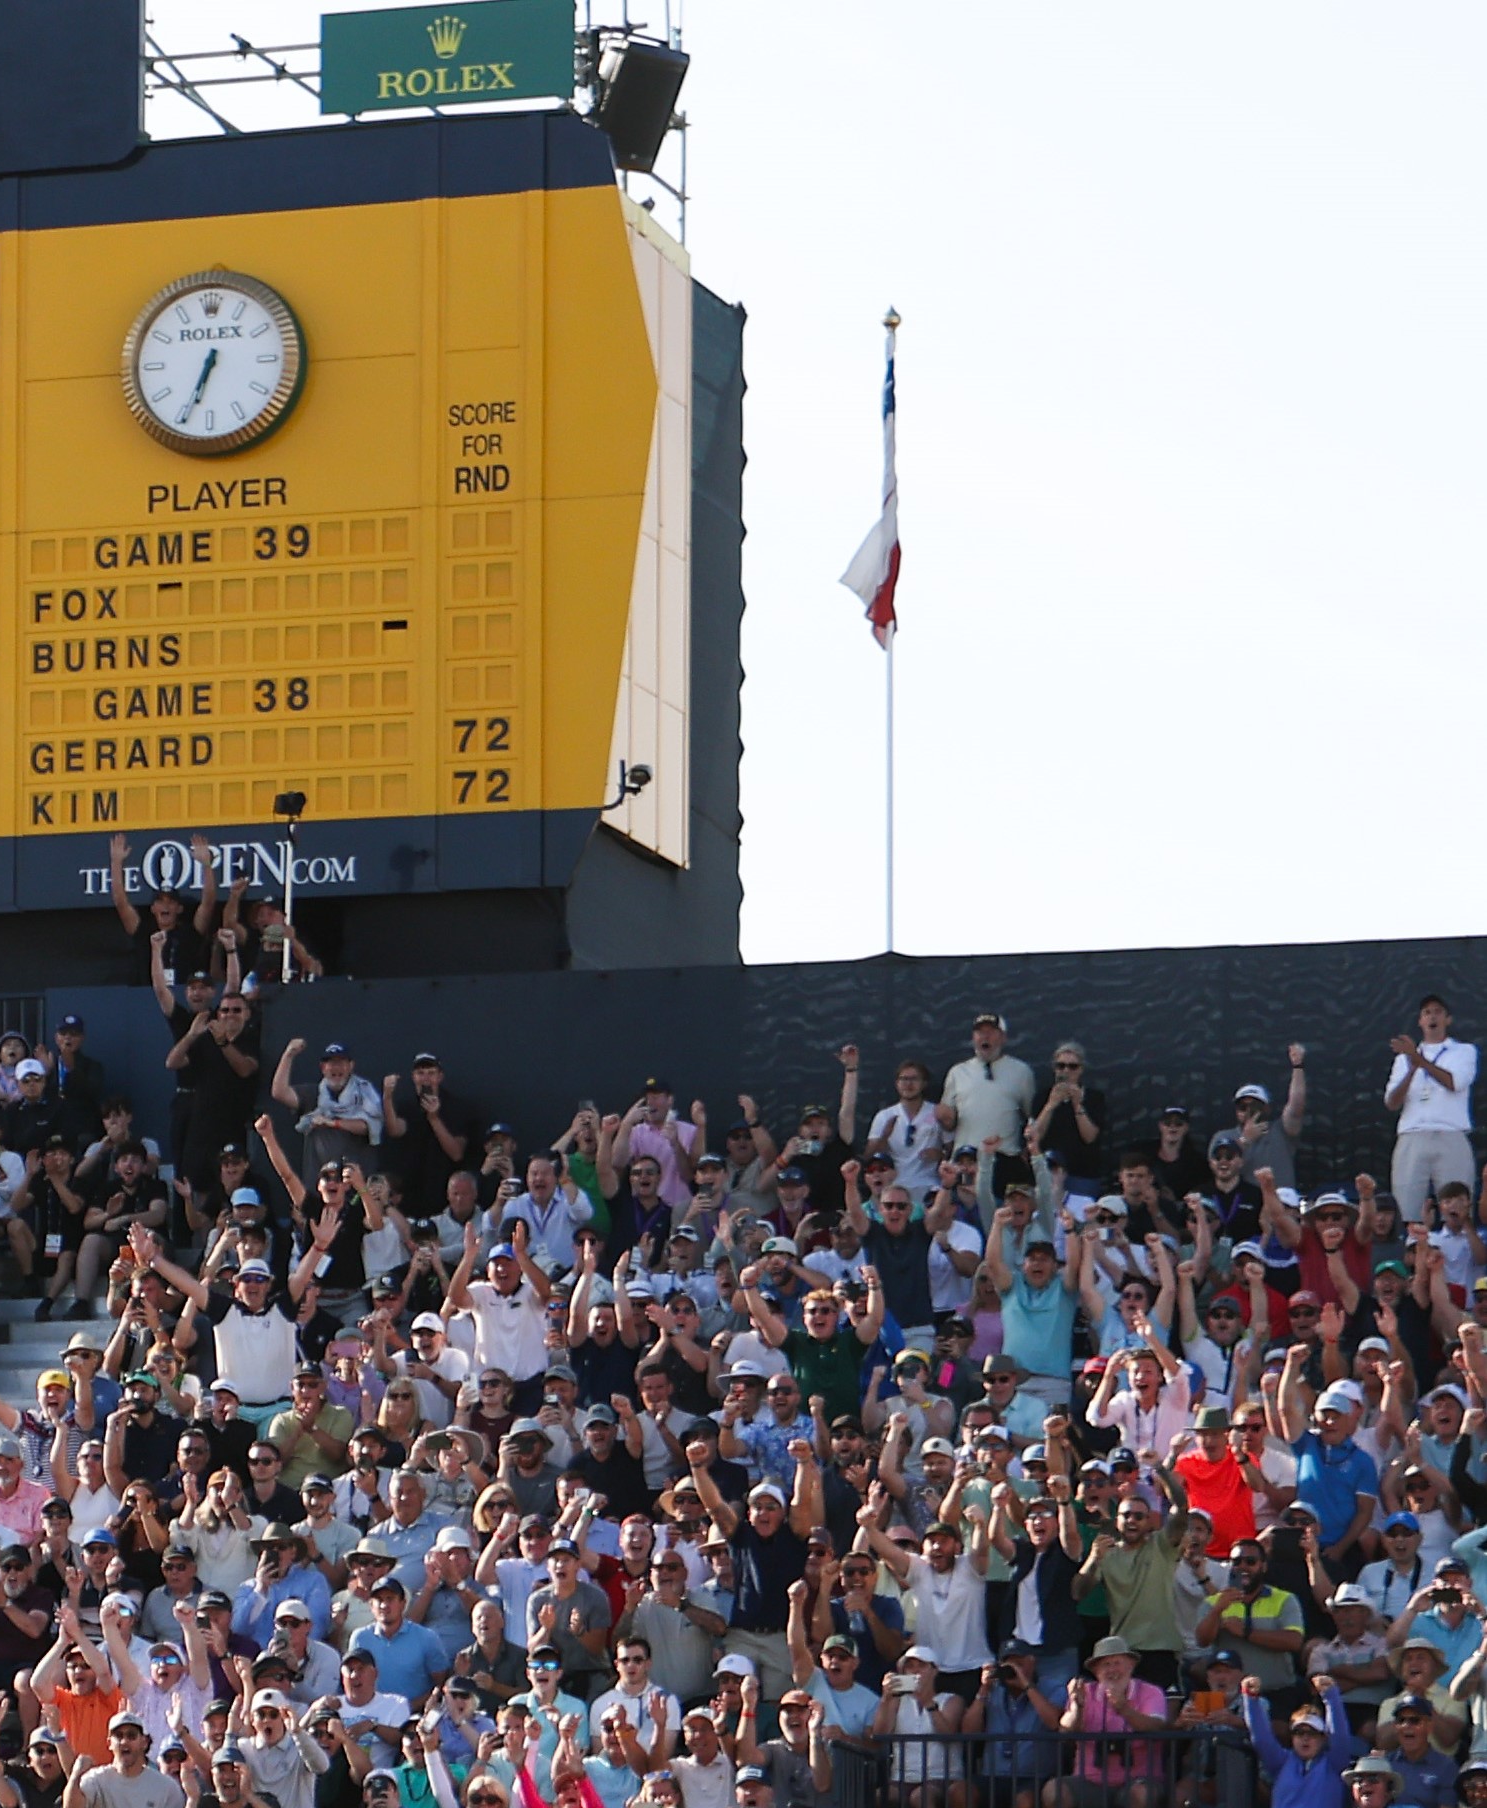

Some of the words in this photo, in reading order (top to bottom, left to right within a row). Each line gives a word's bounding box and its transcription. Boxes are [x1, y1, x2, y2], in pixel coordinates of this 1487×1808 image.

[377, 62, 515, 99] ROLEX
[179, 325, 242, 342] ROLEX
[448, 402, 516, 427] SCORE
[462, 434, 502, 456] FOR
[147, 477, 287, 512] PLAYER
[455, 465, 509, 494] RND
[95, 531, 212, 570] GAME
[254, 524, 310, 561] 39
[34, 587, 117, 623] FOX
[33, 634, 180, 675] BURNS
[95, 683, 212, 721] GAME
[254, 677, 309, 713] 38
[452, 717, 510, 752] 72
[31, 734, 214, 776] GERARD
[452, 769, 510, 804] 72
[33, 790, 118, 826] KIM
